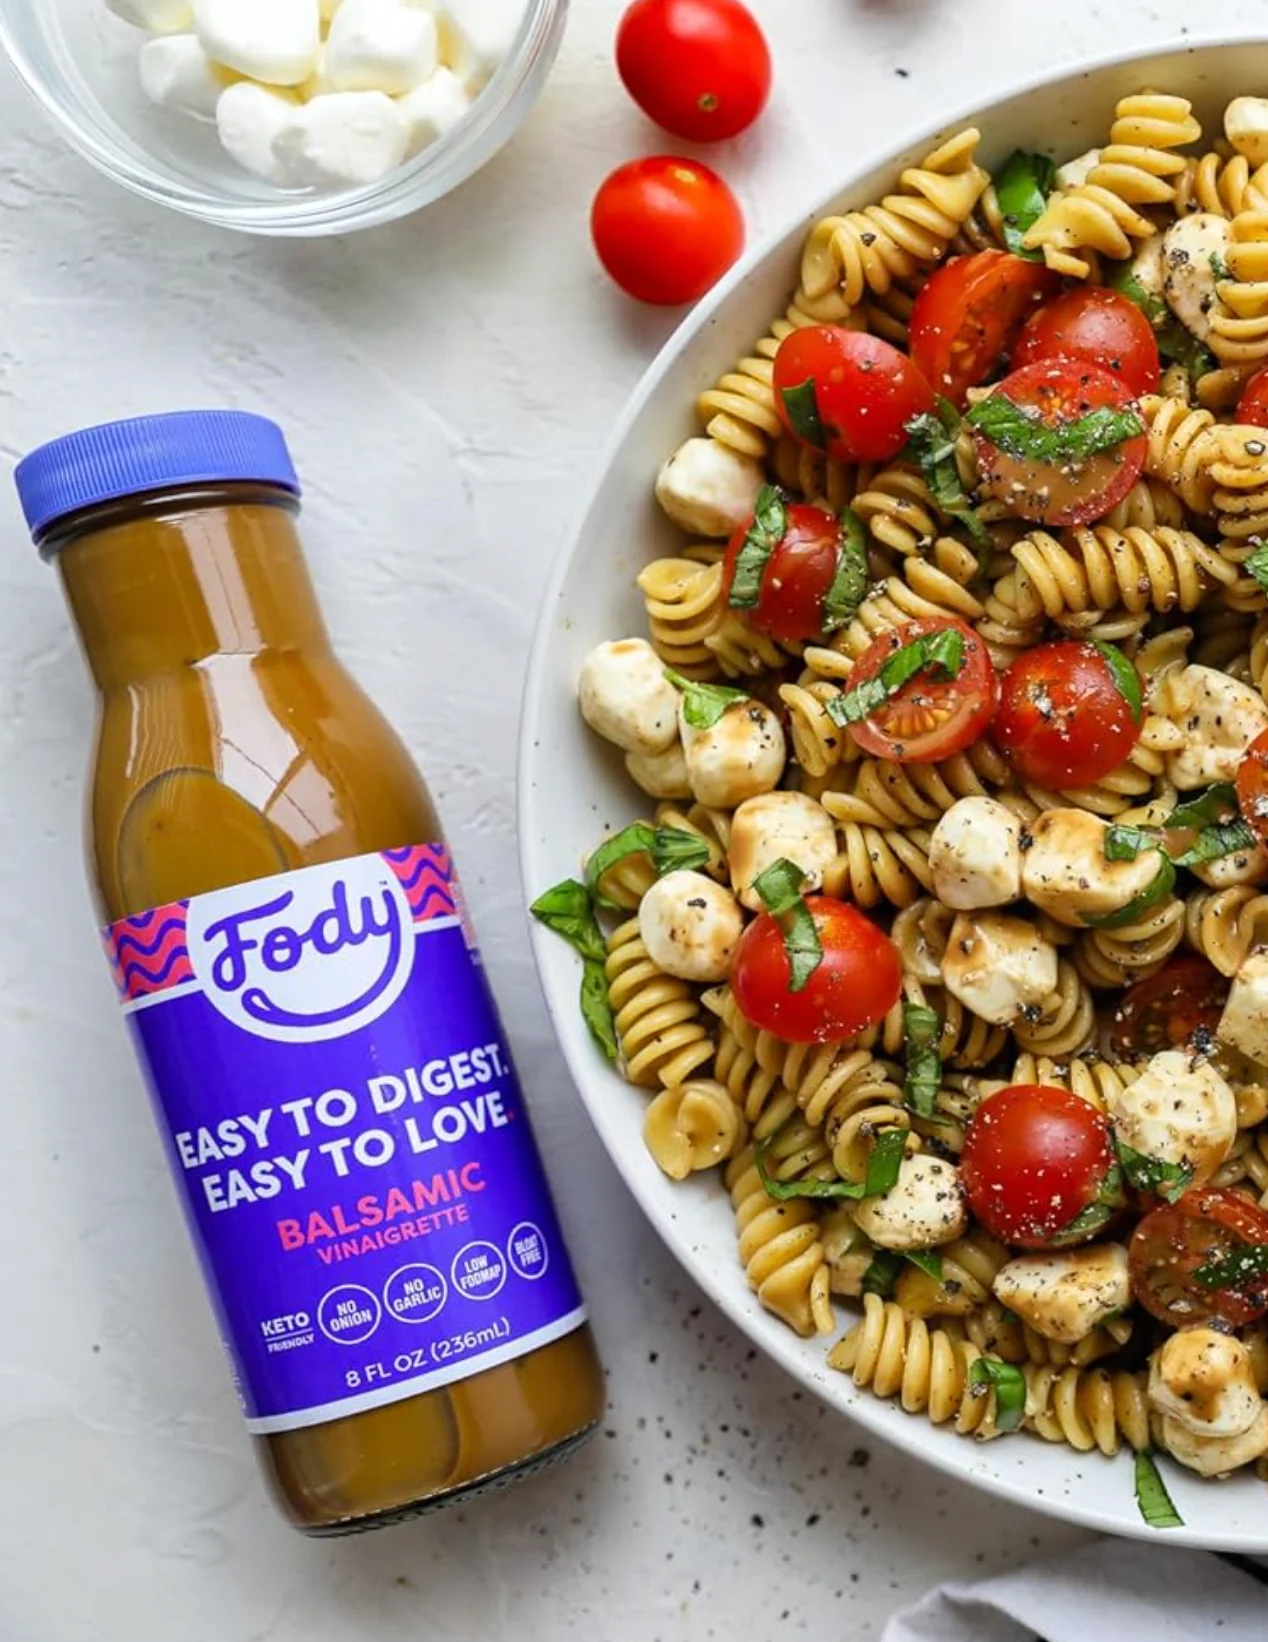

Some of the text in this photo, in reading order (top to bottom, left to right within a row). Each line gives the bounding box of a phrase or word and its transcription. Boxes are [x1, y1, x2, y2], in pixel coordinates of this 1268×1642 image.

[203, 880, 402, 1027] Fody
[175, 1043, 510, 1170] EASY TO DIGEST.
[202, 1149, 311, 1213] EASY
[319, 1129, 396, 1177] TO
[276, 1162, 486, 1251] BALSAMIC
[316, 1203, 470, 1265] VINAIGRETTE
[514, 1235, 538, 1254] BLOAT
[464, 1255, 488, 1273] LOW
[520, 1248, 542, 1267] FREE
[403, 1278, 425, 1295] NO
[460, 1264, 502, 1291] FODMAP
[336, 1300, 358, 1317] NO
[393, 1285, 442, 1312] GARLIC
[261, 1311, 311, 1336] KETO
[330, 1312, 373, 1333] ONION
[267, 1332, 315, 1354] FRIENDLY
[346, 1316, 511, 1388] 8 FL OZ (236mL)
